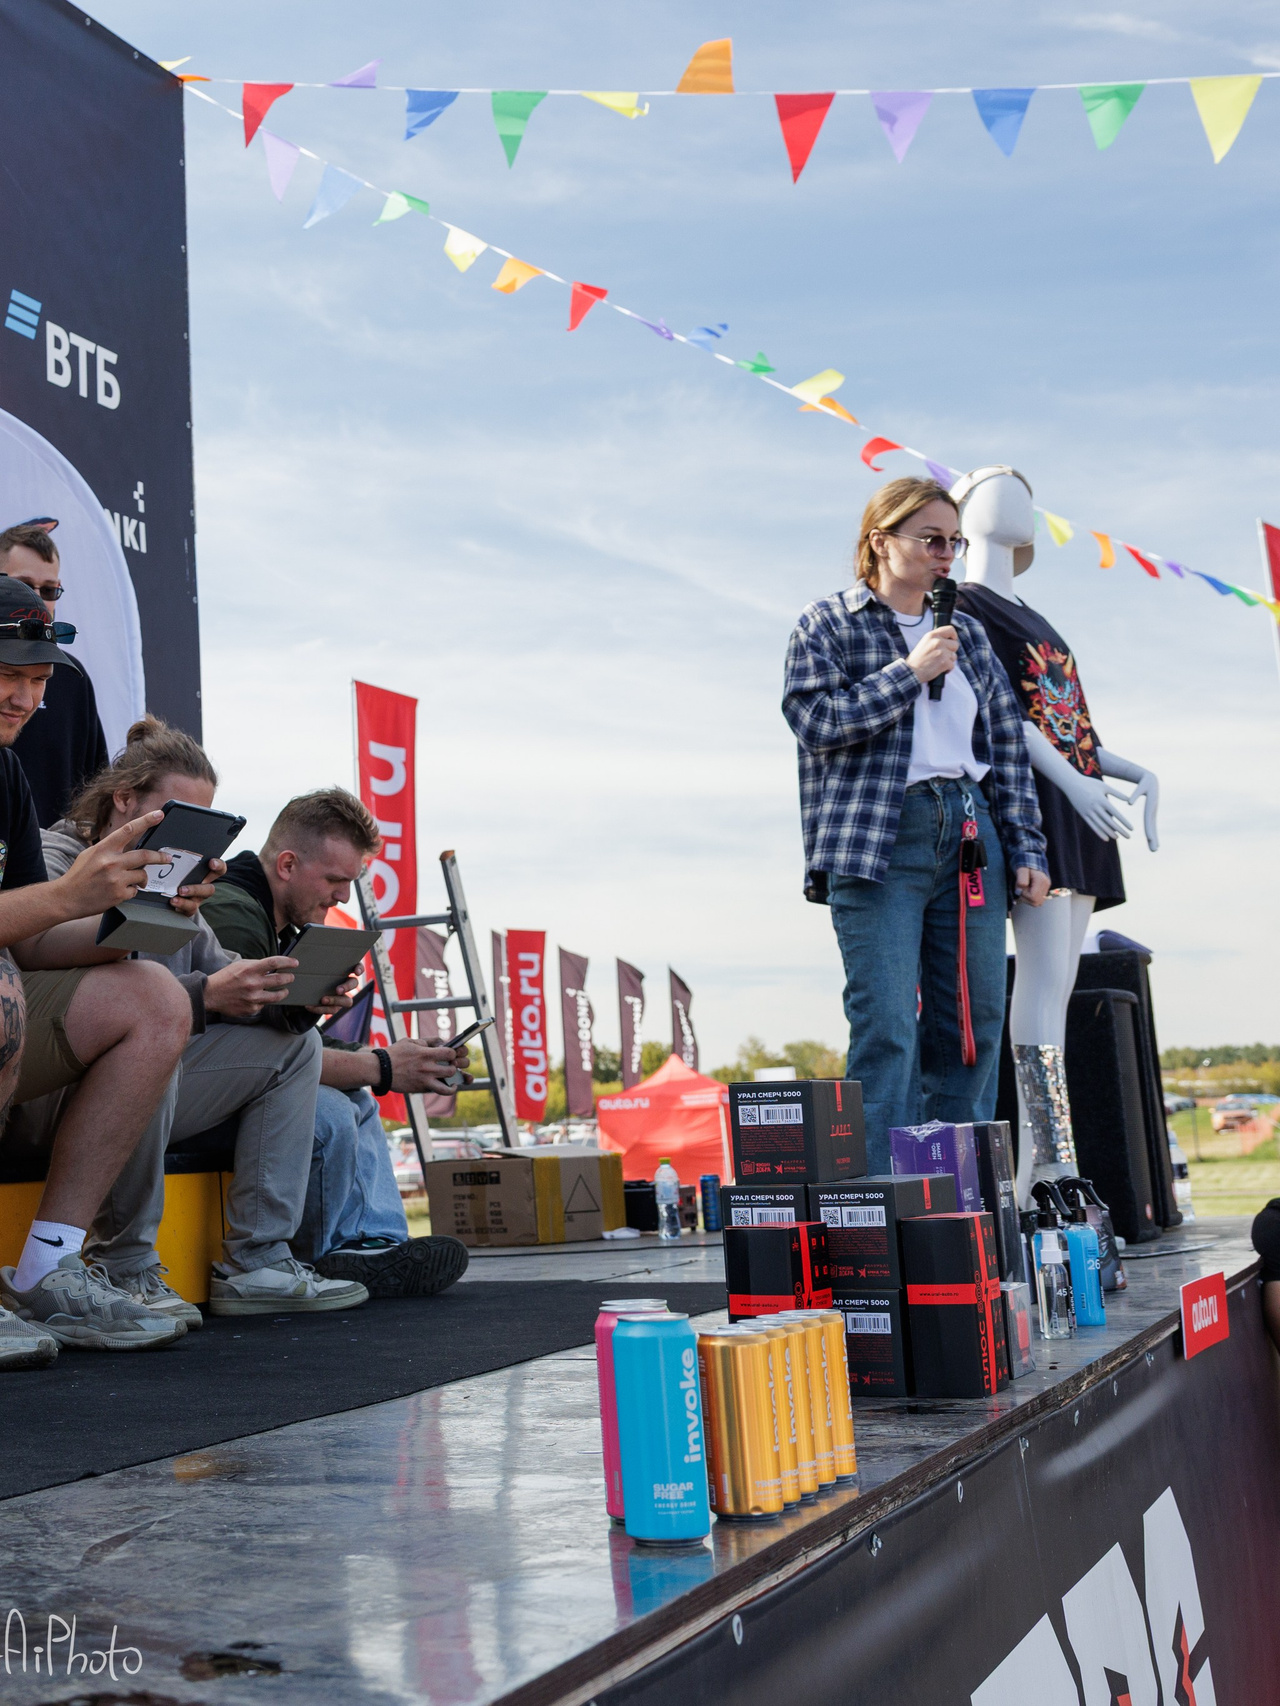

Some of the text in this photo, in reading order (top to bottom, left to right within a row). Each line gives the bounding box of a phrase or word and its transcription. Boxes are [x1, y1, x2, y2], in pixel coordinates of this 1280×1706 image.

[45, 320, 121, 410] ВТБ
[518, 952, 548, 1101] auto.ru
[598, 1097, 650, 1110] auto.ru
[1086, 1259, 1101, 1270] 26
[1056, 1288, 1068, 1297] 45
[1191, 1294, 1219, 1334] auto.ru
[978, 1321, 991, 1390] ПЛЮС
[679, 1347, 702, 1464] invoke
[653, 1481, 694, 1492] SUGAR
[653, 1490, 684, 1500] FREE
